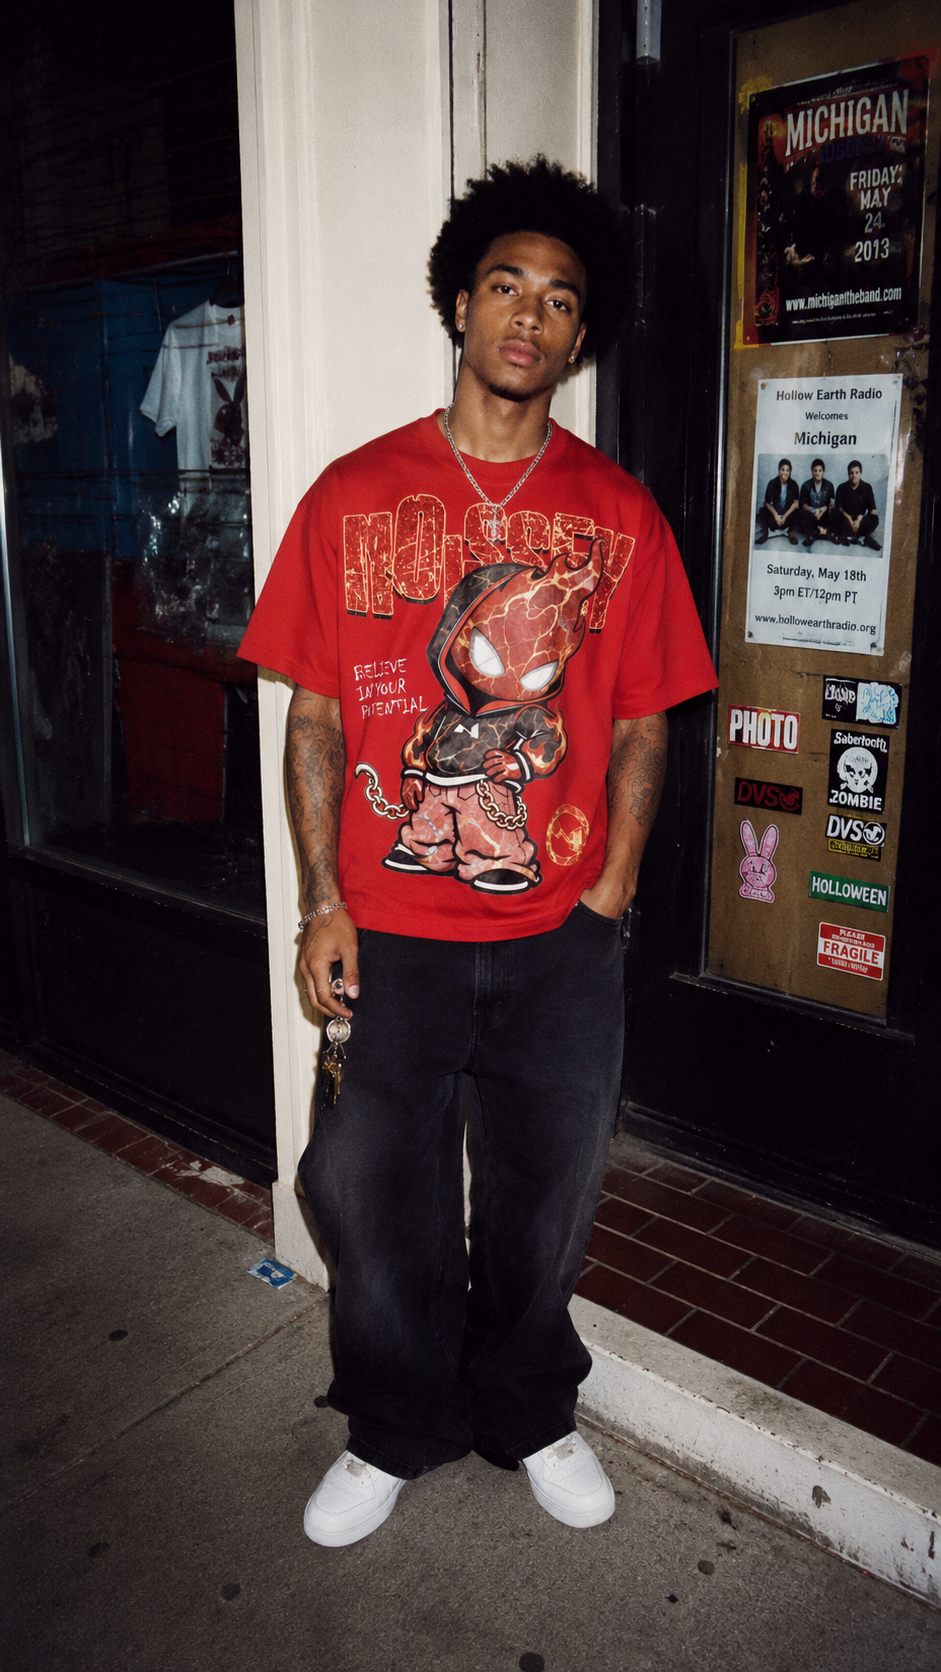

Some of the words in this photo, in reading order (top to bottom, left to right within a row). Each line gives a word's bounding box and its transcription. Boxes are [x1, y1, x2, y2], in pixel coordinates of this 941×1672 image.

[785, 89, 909, 157] MICHIGAN
[860, 186, 892, 211] MAY
[854, 237, 890, 263] 2013
[776, 390, 813, 401] Hollow
[816, 388, 847, 401] Earth
[849, 387, 883, 400] Radio
[805, 411, 849, 421] Welcomes
[794, 431, 857, 449] Michigan
[766, 563, 815, 580] Saturday,
[817, 567, 841, 583] May
[844, 569, 867, 582] 18th
[773, 585, 795, 600] 3pm
[797, 586, 842, 604] ET/12pm
[844, 590, 859, 605] PT
[754, 613, 877, 636] www.hollowearthradio.org
[355, 682, 374, 702] IN
[374, 677, 407, 697] YOUR
[729, 708, 798, 750] PHOTO
[736, 780, 781, 808] DVS
[829, 789, 883, 812] ZOMBIE
[826, 814, 865, 842] DVS
[811, 875, 888, 907] HOLLOWEEN
[822, 940, 880, 966] FRAGILE
